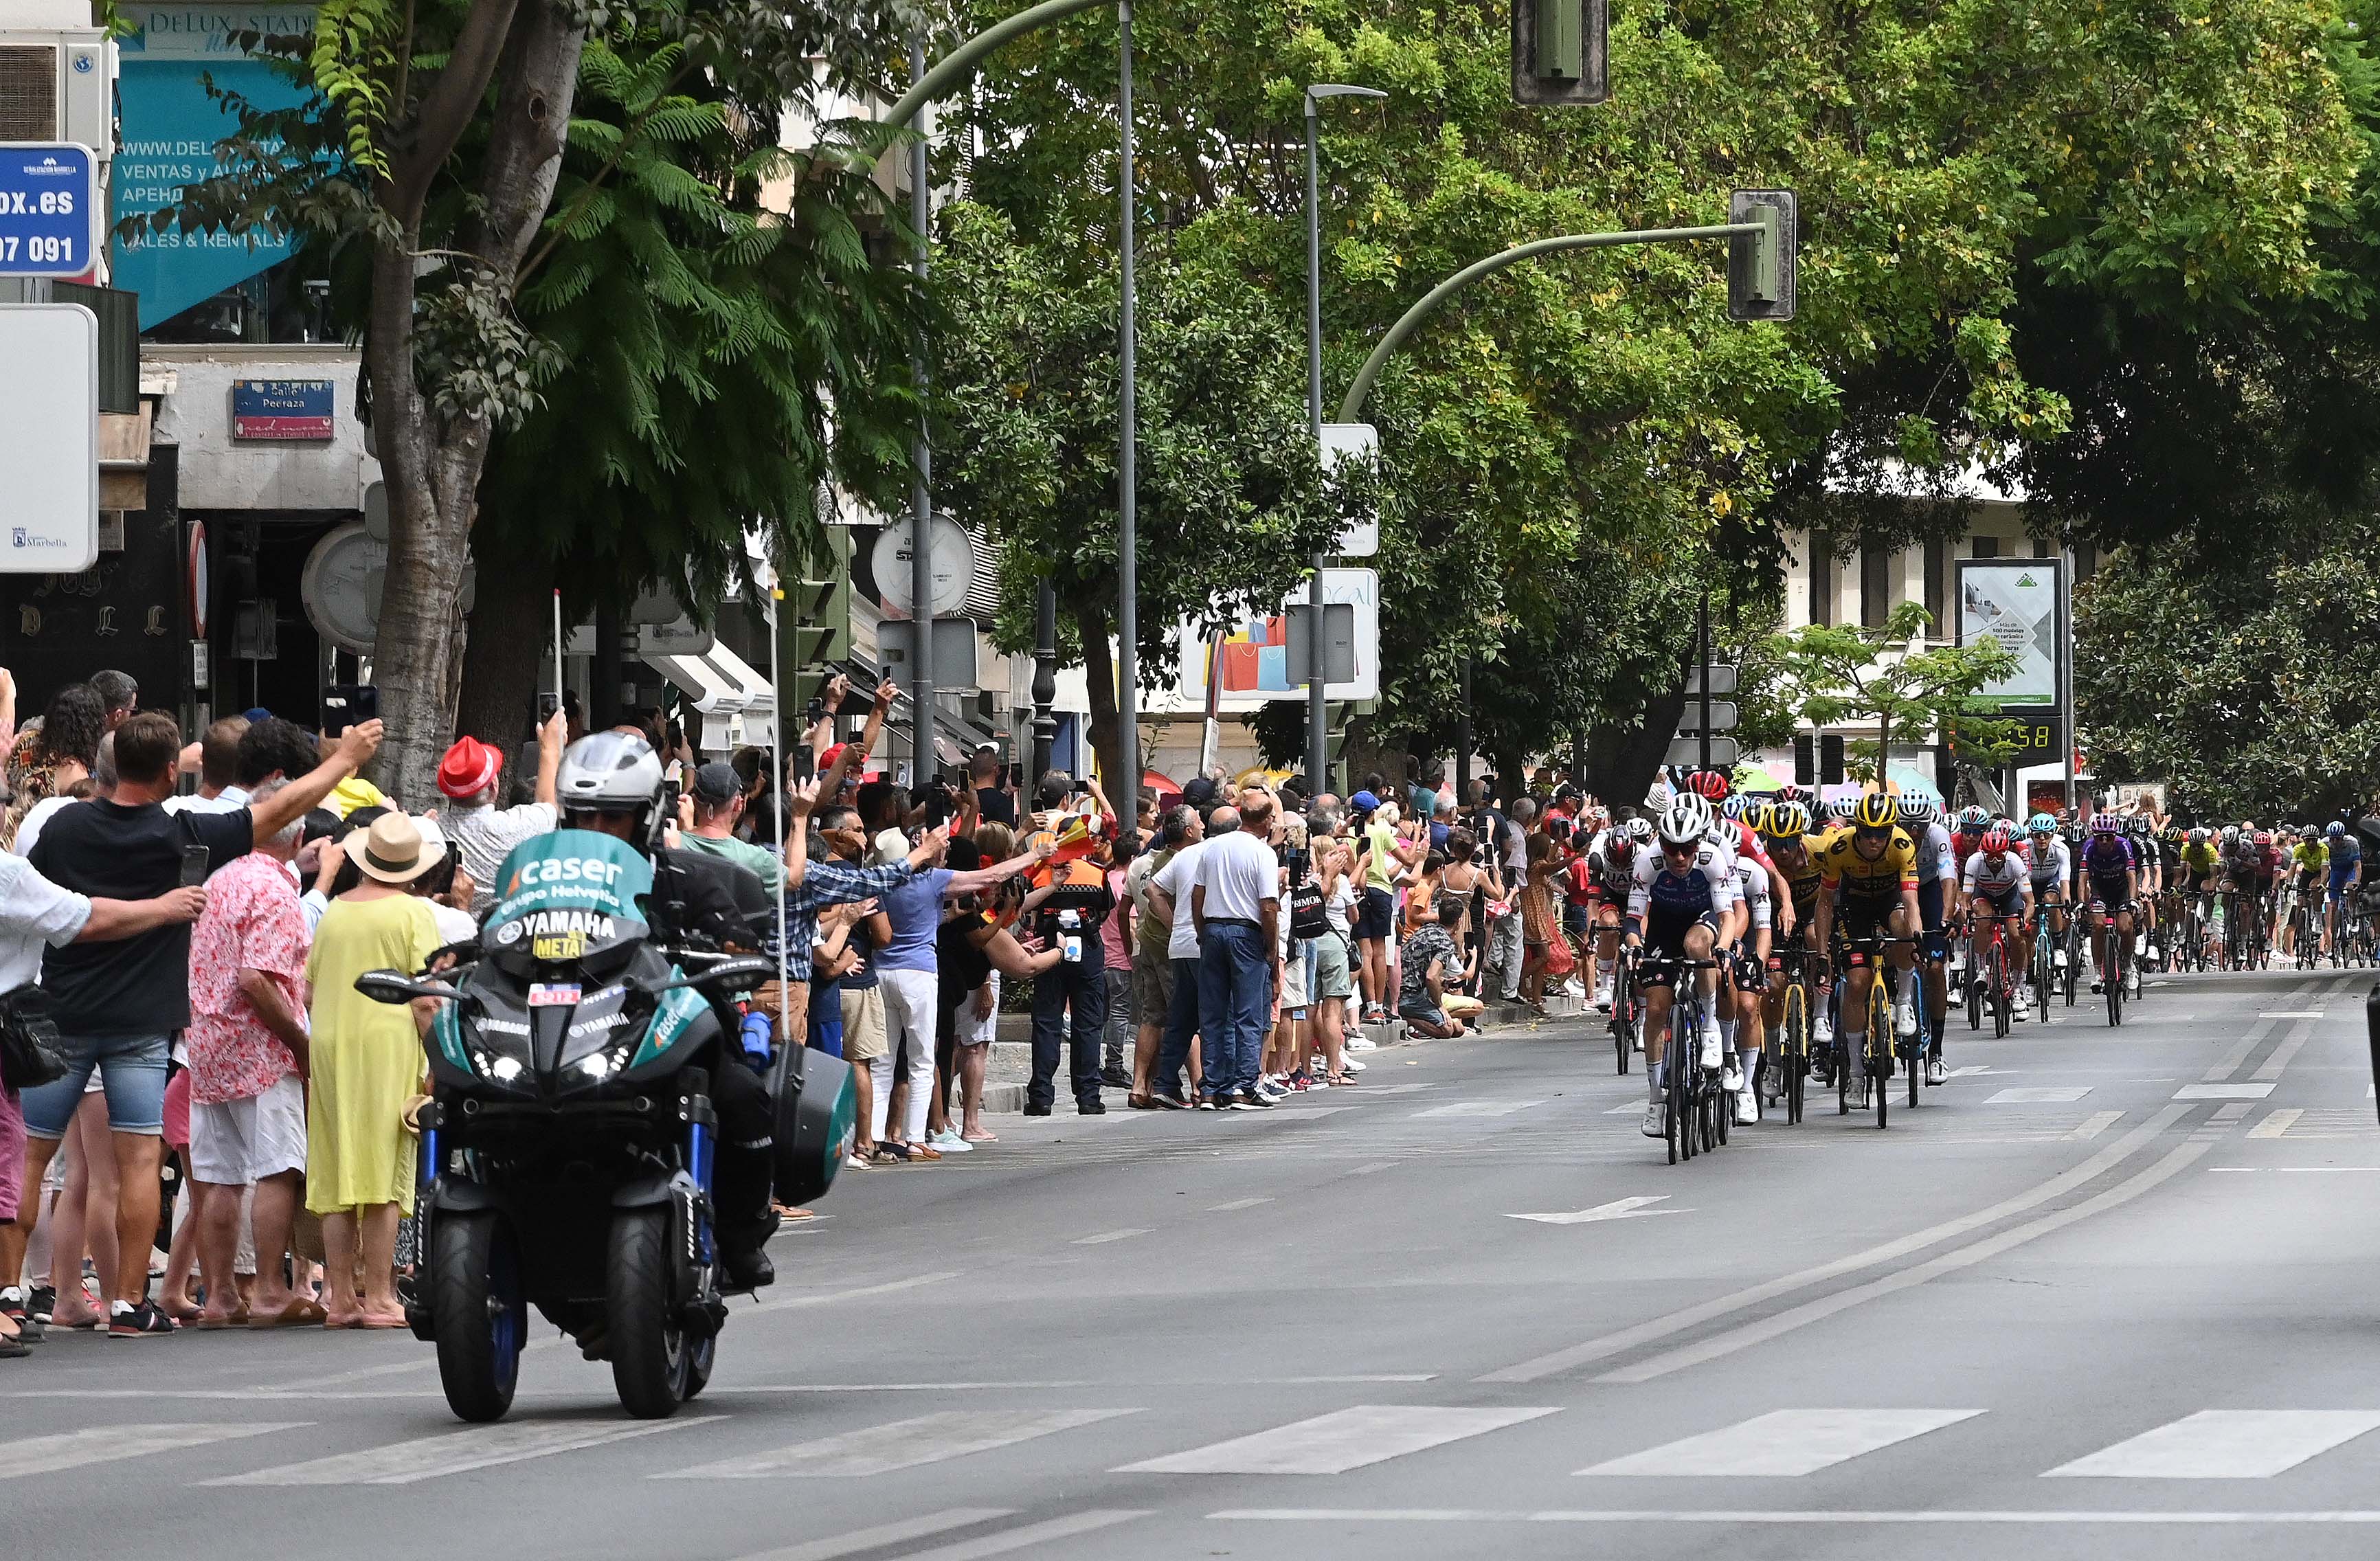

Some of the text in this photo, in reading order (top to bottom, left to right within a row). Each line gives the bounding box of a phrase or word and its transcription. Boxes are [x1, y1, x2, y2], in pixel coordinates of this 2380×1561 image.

[122, 164, 192, 179] VENTAS
[198, 167, 206, 182] y
[0, 236, 71, 262] 7 091
[186, 234, 197, 248] &
[27, 537, 67, 548] Marbella
[521, 857, 622, 885] caser
[551, 885, 620, 908] Helvetia
[523, 911, 616, 939] YAMAHA
[536, 938, 581, 957] META
